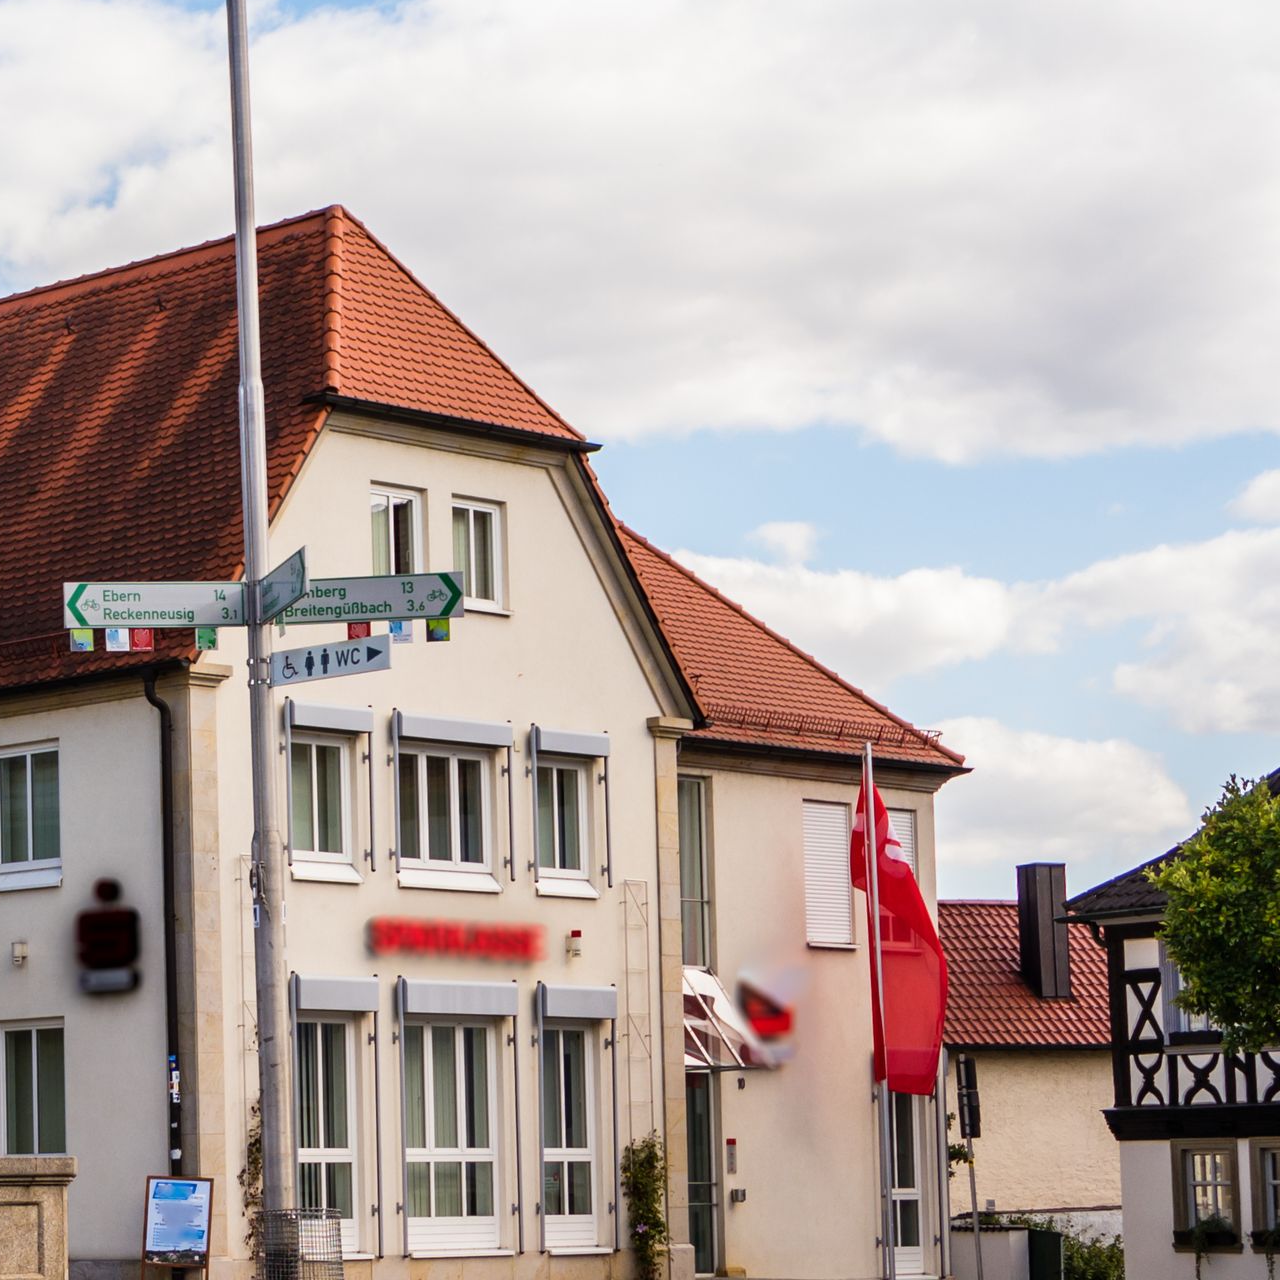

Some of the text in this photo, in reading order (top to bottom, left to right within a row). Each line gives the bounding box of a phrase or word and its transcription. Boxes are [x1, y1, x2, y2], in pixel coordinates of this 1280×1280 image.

[401, 581, 414, 594] 13
[102, 589, 226, 602] Ebern 14
[103, 607, 195, 623] Reckenneusig
[285, 601, 393, 618] Breitengüßbach
[335, 647, 361, 667] WC
[737, 1077, 746, 1090] 10
